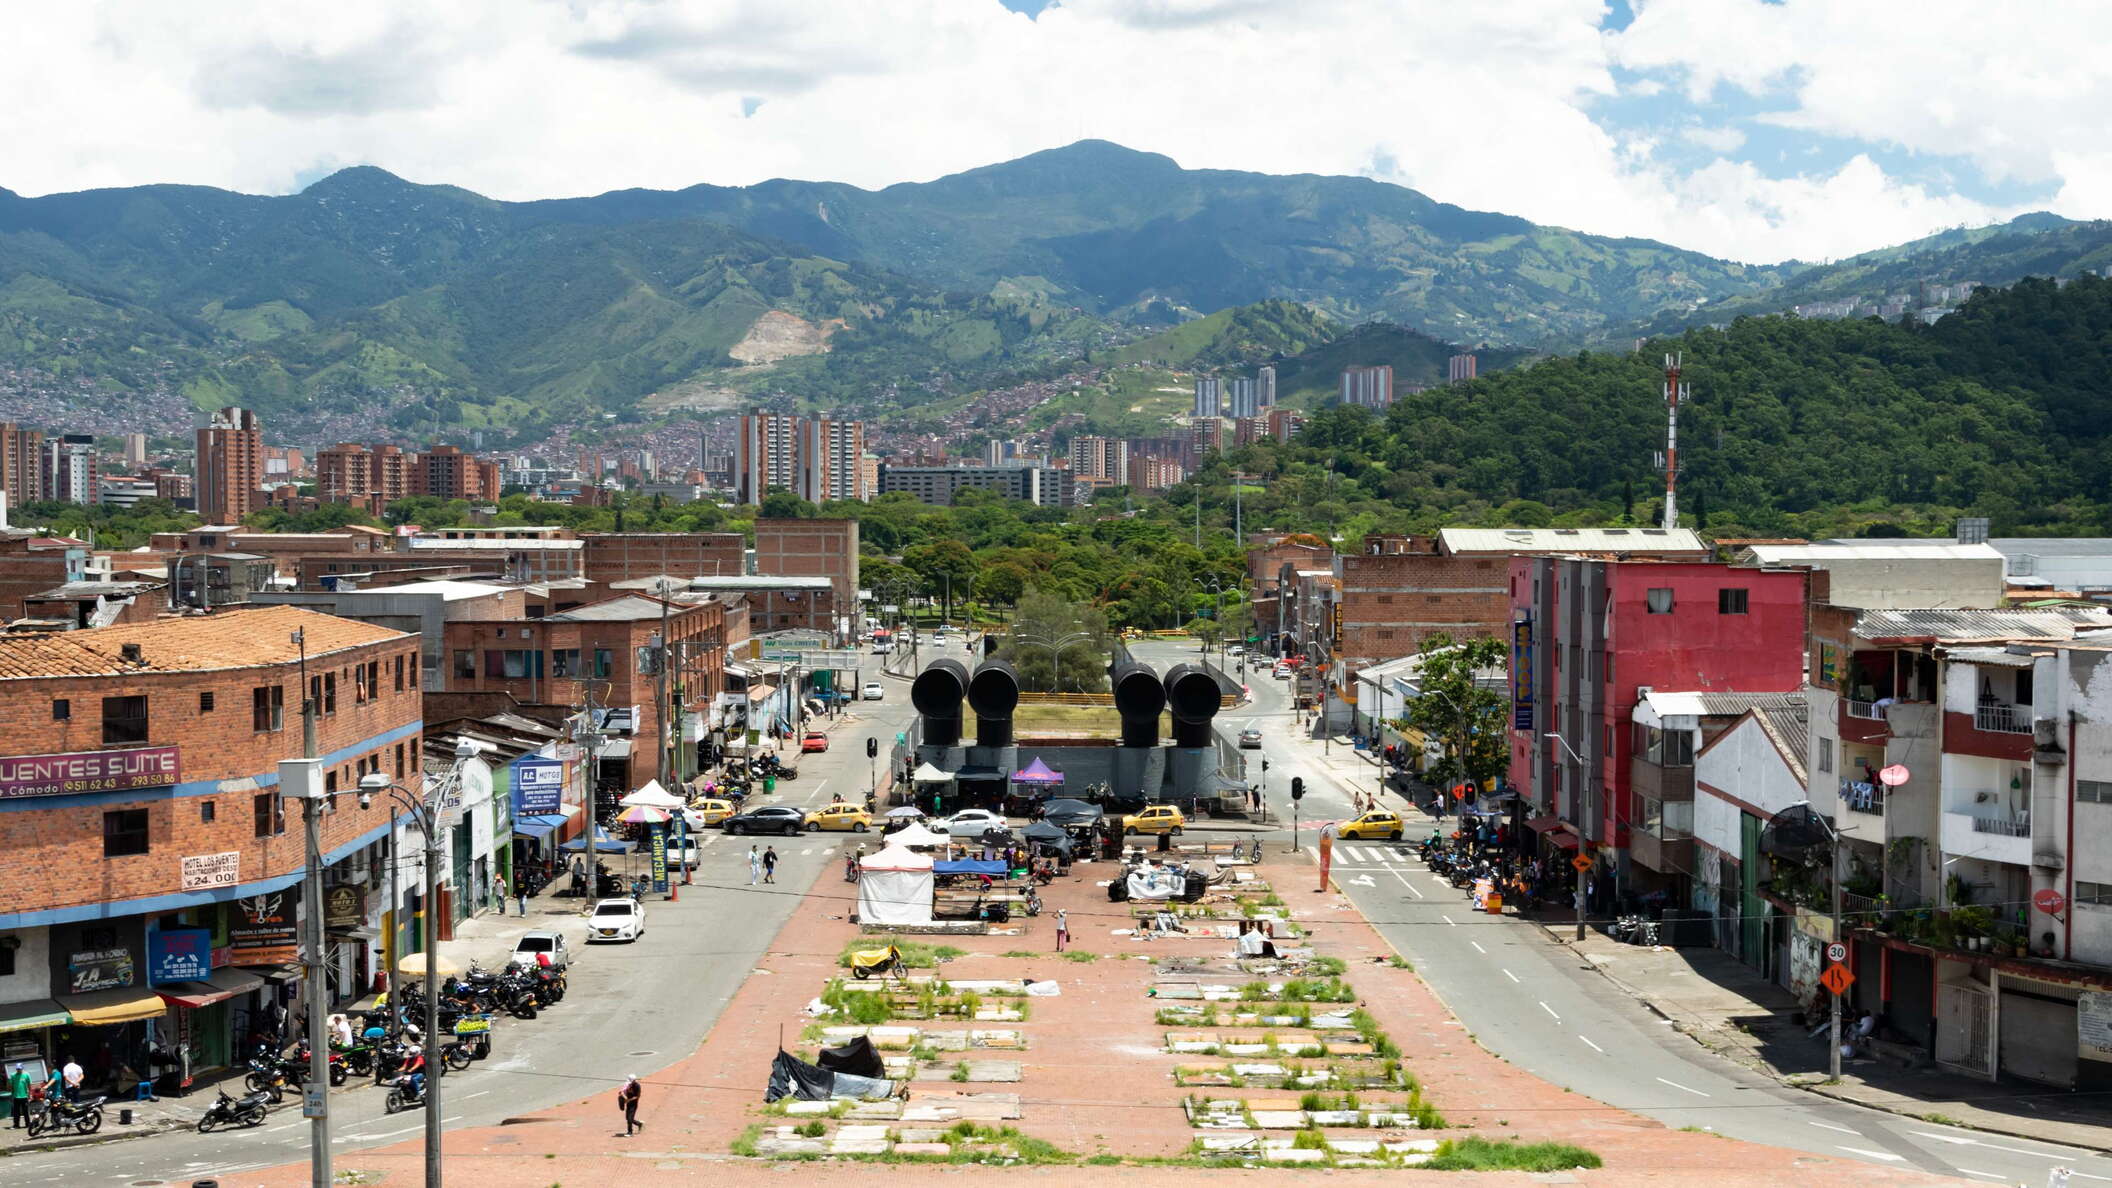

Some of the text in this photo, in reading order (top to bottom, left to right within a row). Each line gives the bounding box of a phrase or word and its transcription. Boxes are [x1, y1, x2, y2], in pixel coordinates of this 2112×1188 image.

[108, 752, 175, 776] SUITE
[9, 783, 58, 796] Cómodo
[90, 780, 101, 790] 62
[104, 778, 116, 789] 43
[132, 776, 148, 786] 293
[151, 775, 162, 785] 50
[165, 773, 175, 783] 86
[184, 857, 203, 869] HOTEL
[216, 853, 238, 866] PUENTES
[1830, 946, 1844, 957] 30
